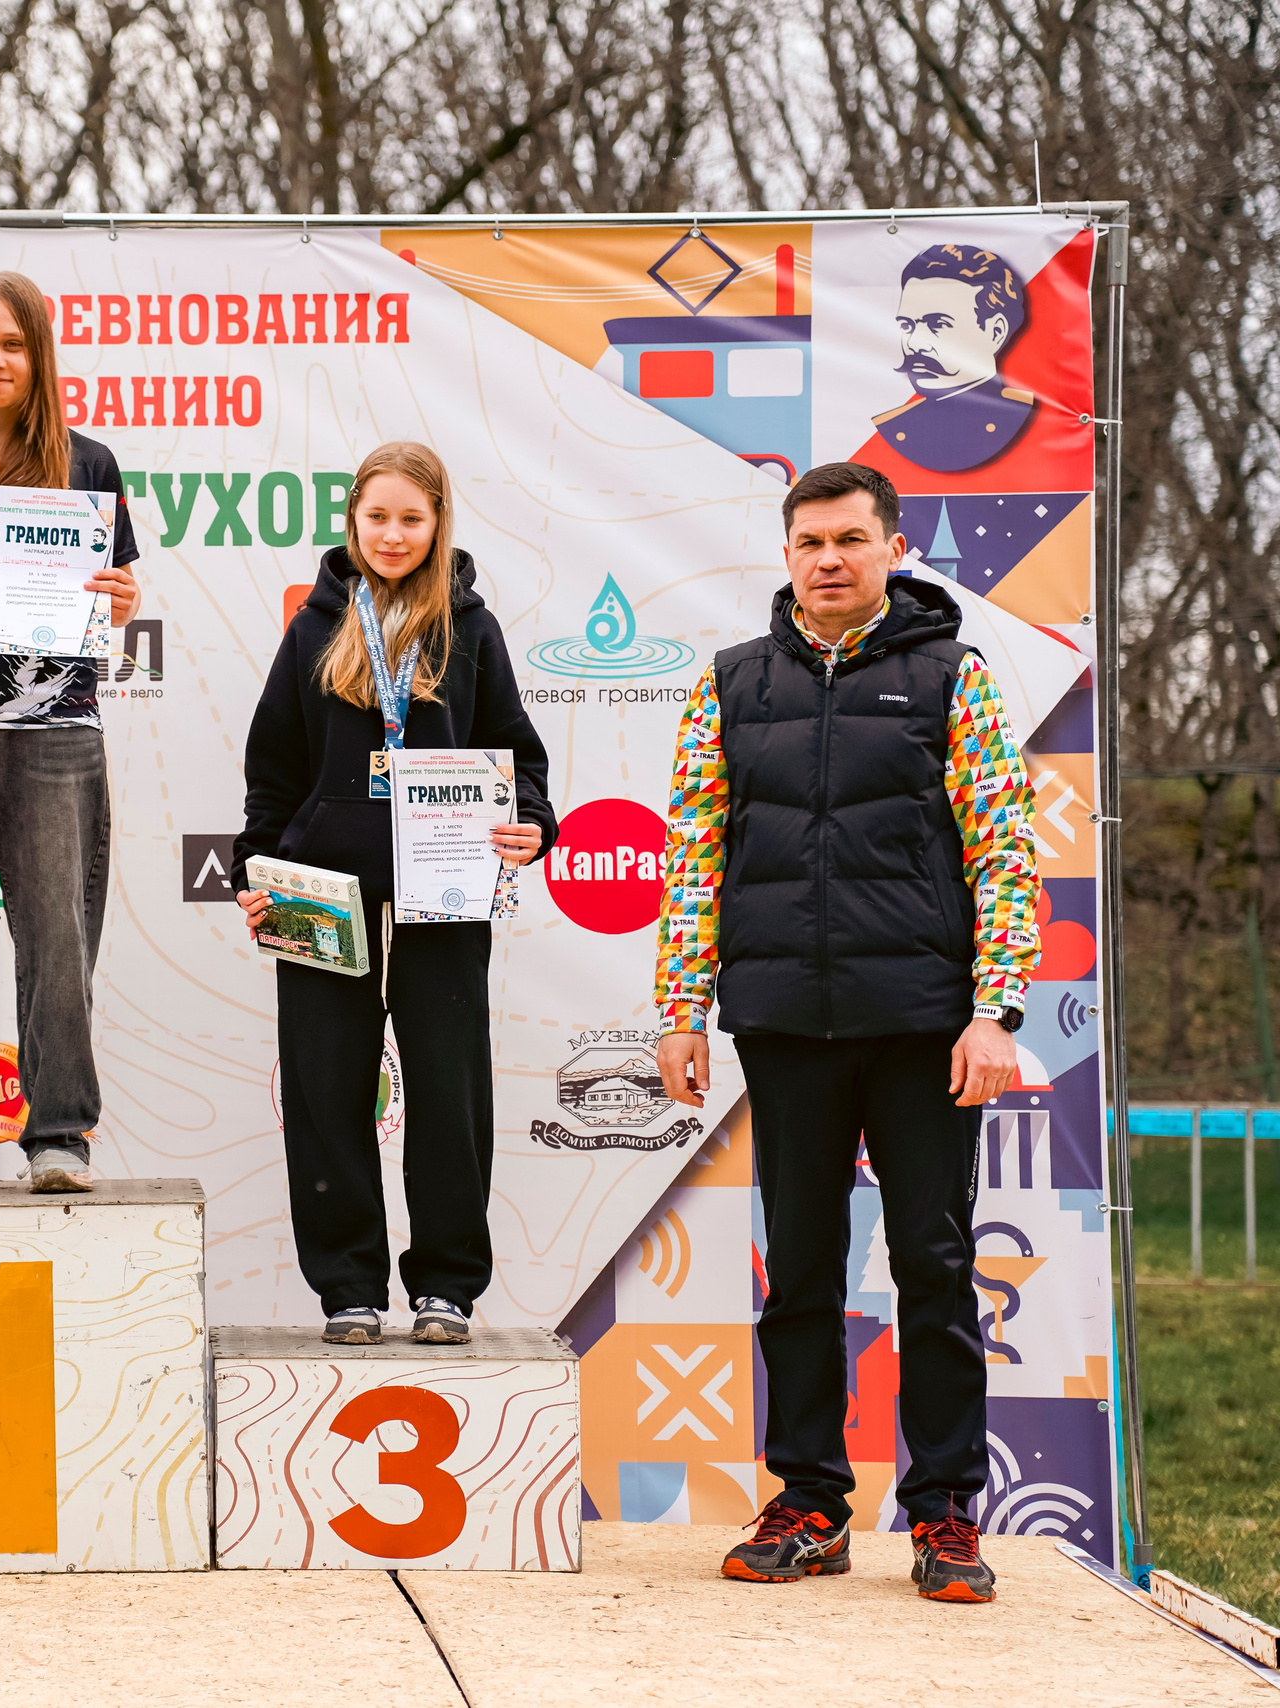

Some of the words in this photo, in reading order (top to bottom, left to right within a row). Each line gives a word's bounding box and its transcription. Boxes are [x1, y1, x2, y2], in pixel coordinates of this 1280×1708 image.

[5, 525, 80, 547] ГРАМОТА
[130, 688, 163, 698] вело
[519, 688, 586, 704] левая
[598, 687, 693, 707] гравита
[879, 694, 908, 702] STROBBS
[375, 755, 385, 769] 3
[408, 785, 484, 803] ГРАМОТА
[258, 933, 300, 951] ПЯТИГОРСК
[567, 1029, 661, 1051] МУЗЕЙ
[382, 1049, 401, 1104] ятигорск
[328, 1385, 467, 1560] 3
